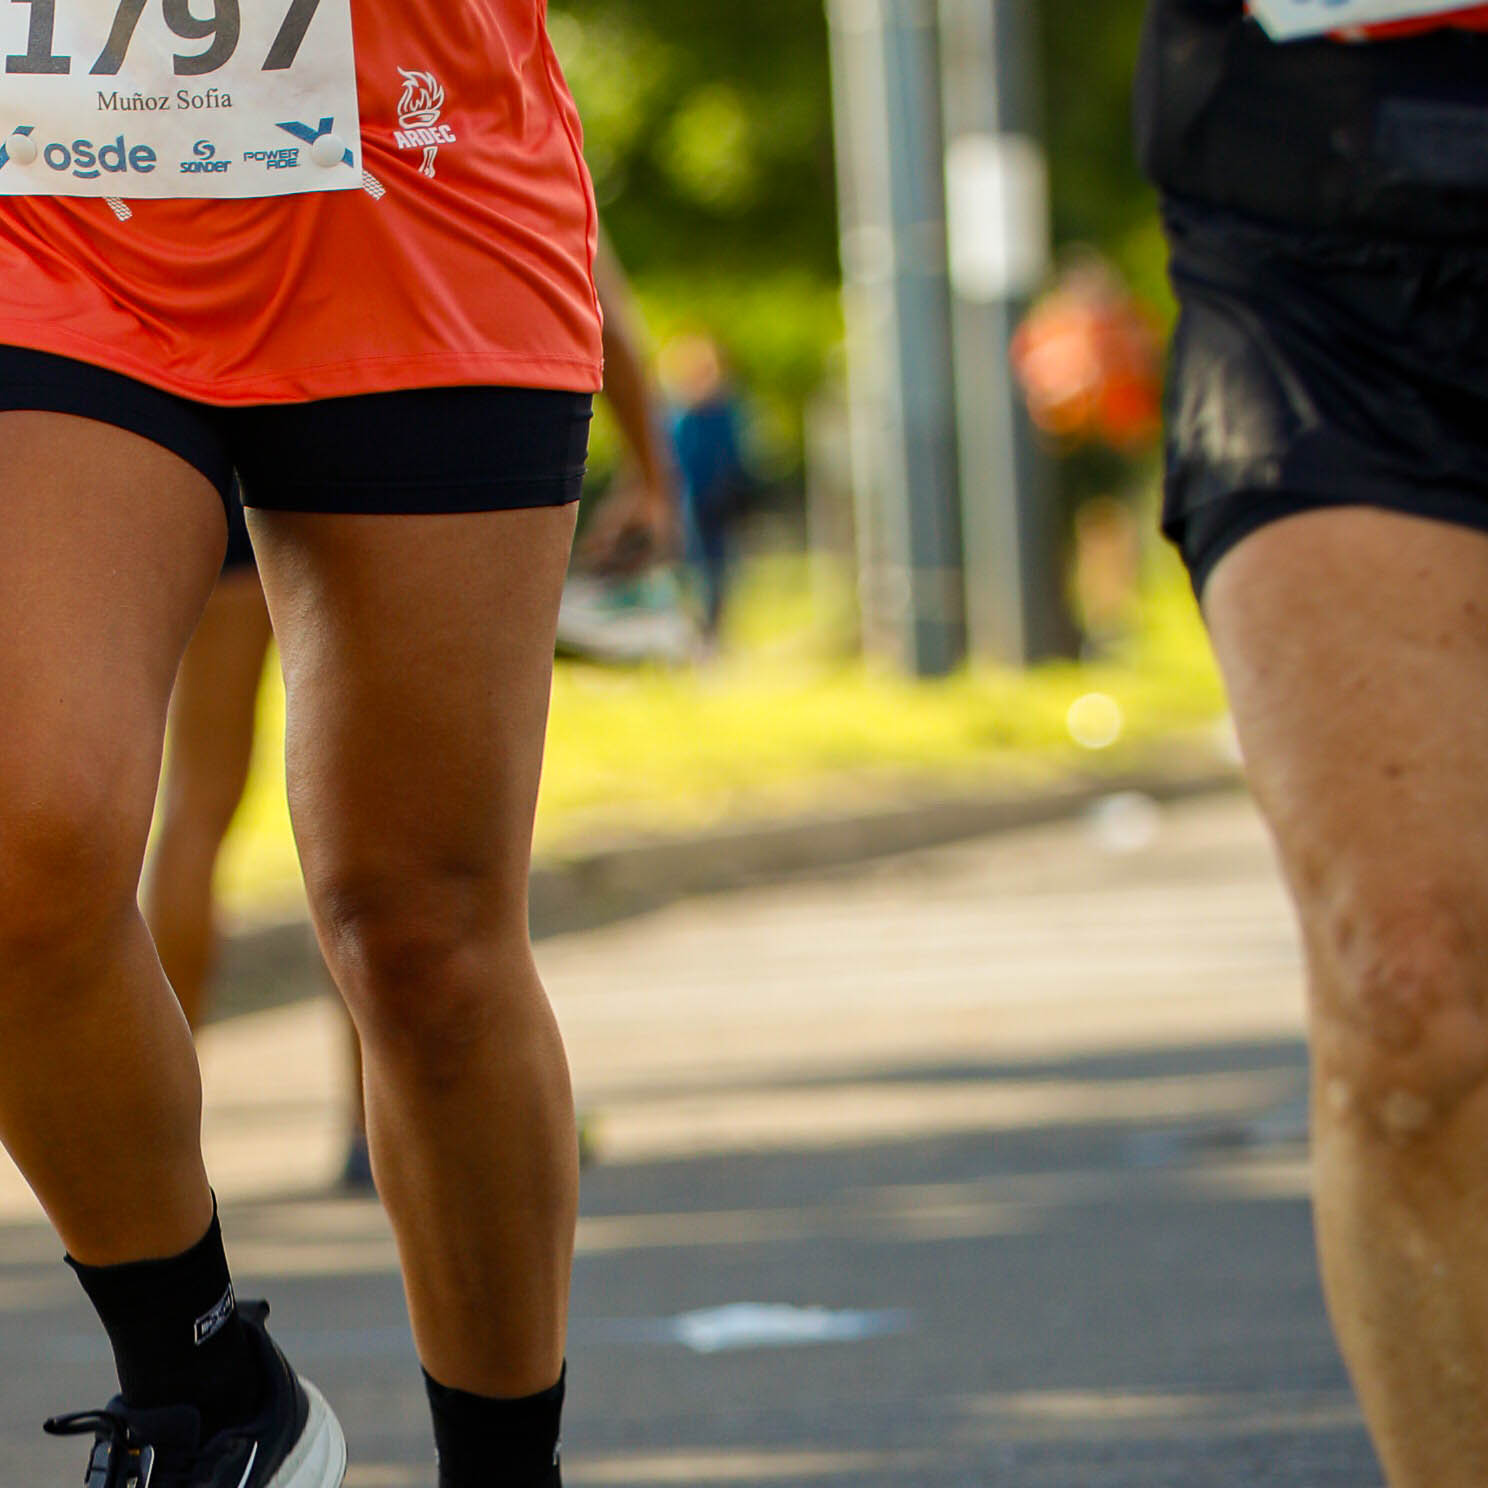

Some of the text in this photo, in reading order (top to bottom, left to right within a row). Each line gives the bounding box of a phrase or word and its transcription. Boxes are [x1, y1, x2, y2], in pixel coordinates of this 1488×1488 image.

[96, 91, 170, 111] Muñoz
[393, 125, 456, 150] ARDEC
[43, 134, 157, 174] osde
[243, 148, 299, 162] POWER
[266, 159, 300, 171] ADE
